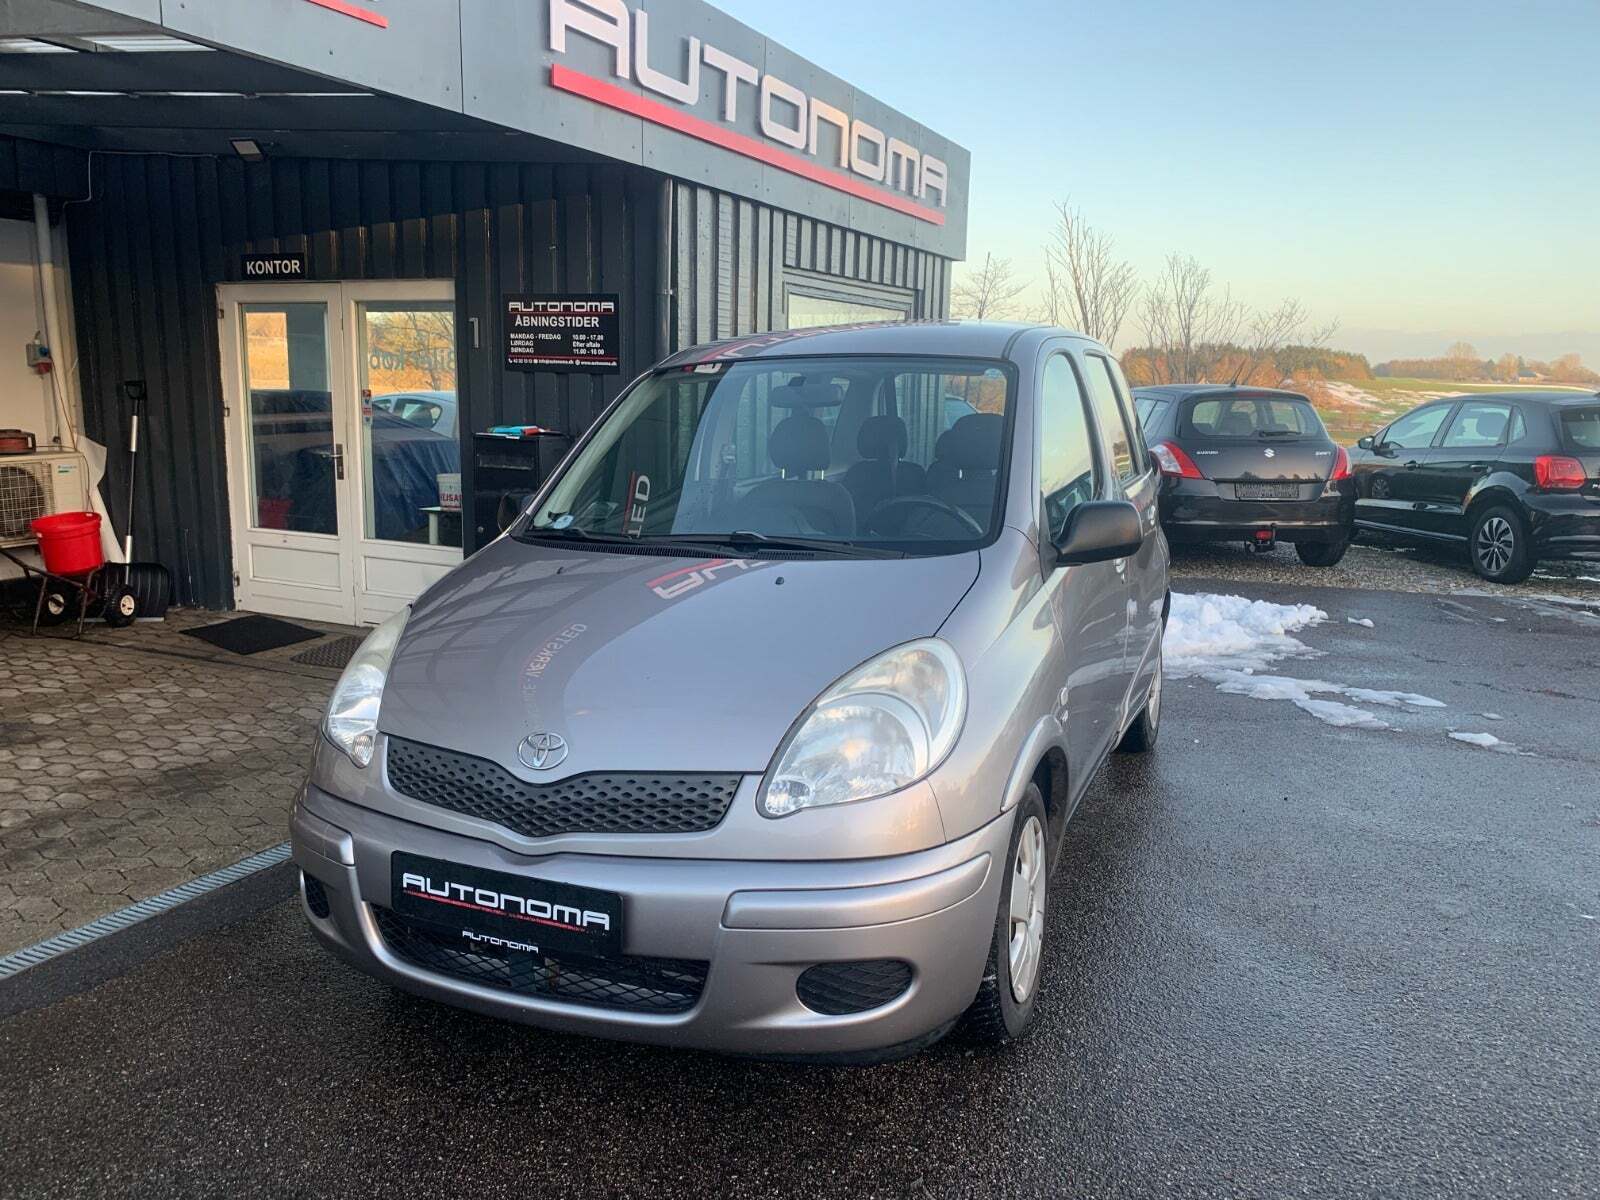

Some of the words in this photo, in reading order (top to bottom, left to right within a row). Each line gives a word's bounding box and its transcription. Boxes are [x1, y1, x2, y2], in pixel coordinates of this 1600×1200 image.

[549, 0, 948, 207] AUTONOMA
[246, 259, 301, 275] KONTOR
[508, 301, 615, 312] AUTONOMA
[514, 314, 600, 328] ÅBNINGSTIDER
[402, 872, 611, 931] AUTONOMA
[462, 930, 539, 954] AUTONOMA
